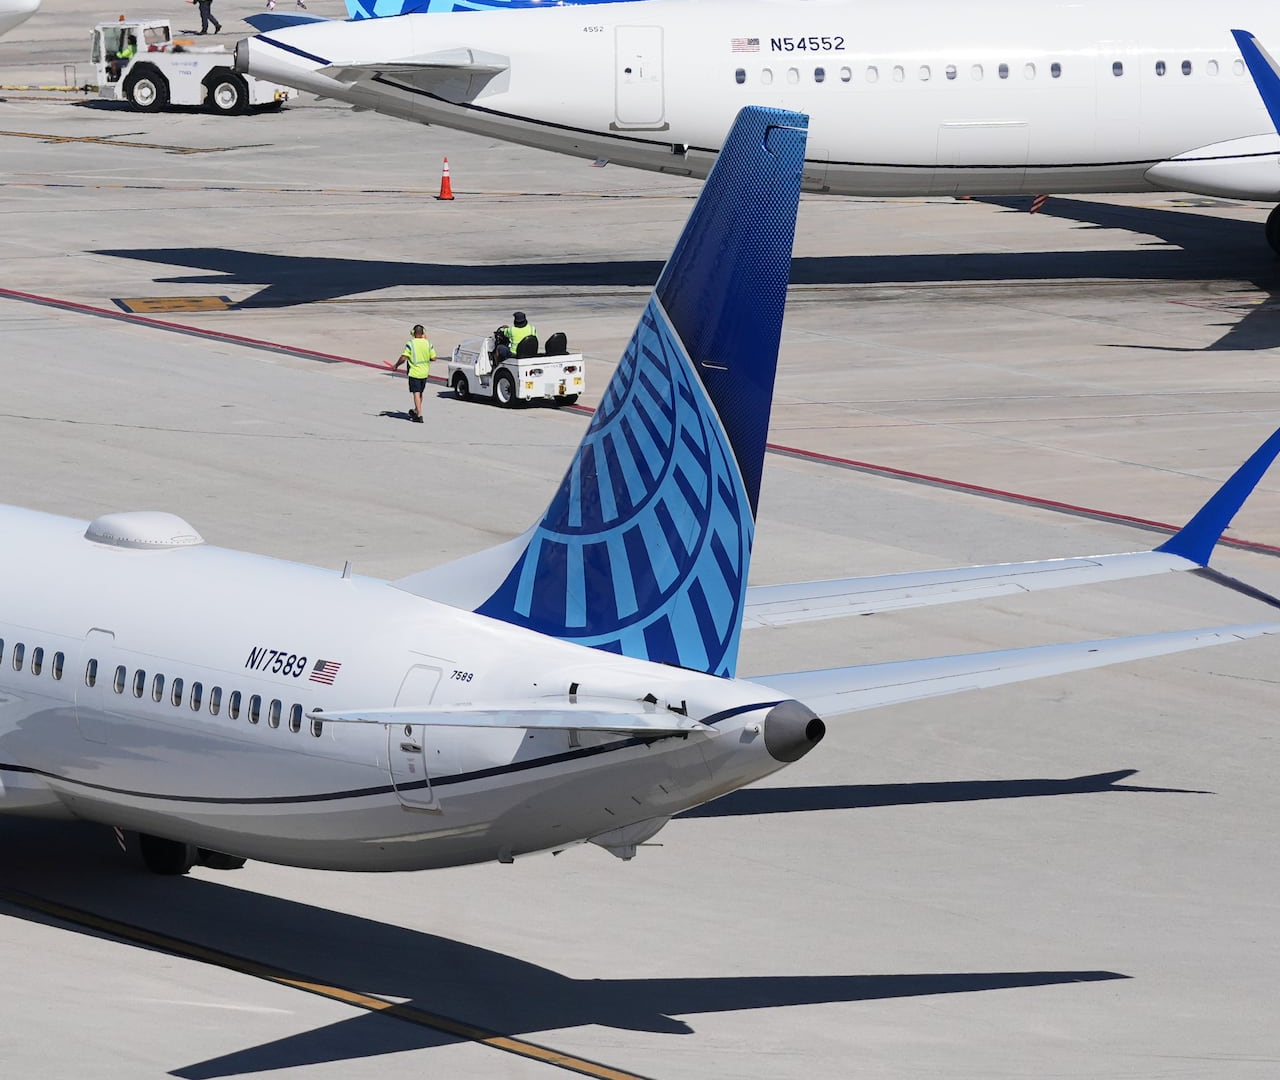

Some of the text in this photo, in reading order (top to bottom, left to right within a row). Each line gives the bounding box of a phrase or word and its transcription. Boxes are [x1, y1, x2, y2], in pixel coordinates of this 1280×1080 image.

[770, 36, 846, 52] N54552
[244, 646, 308, 678] N17589
[450, 670, 474, 683] 7589
